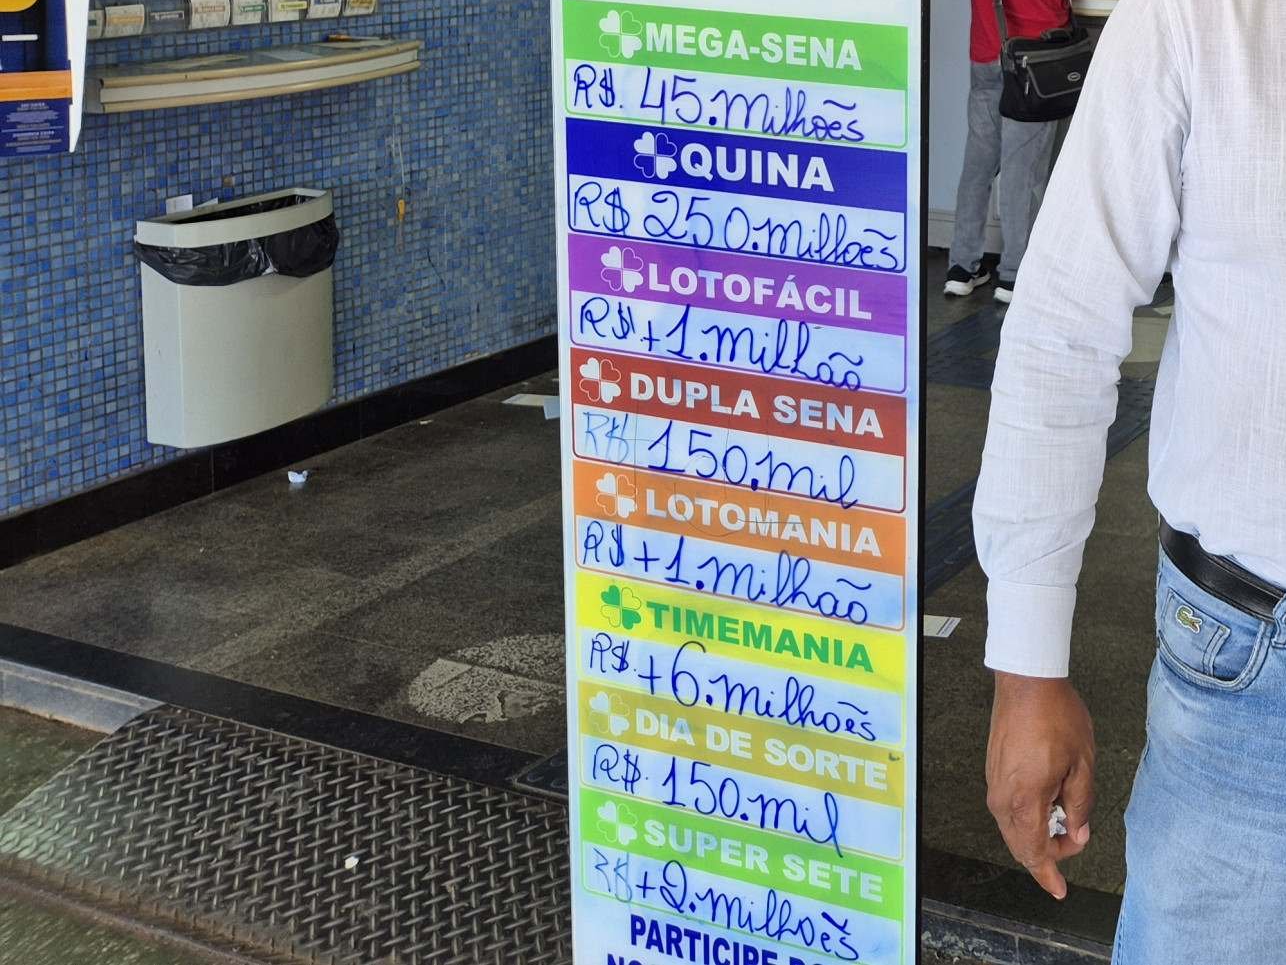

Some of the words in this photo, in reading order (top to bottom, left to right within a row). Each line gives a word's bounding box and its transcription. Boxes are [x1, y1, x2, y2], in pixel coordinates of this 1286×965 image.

[646, 22, 862, 70] MEGA-SENA
[680, 138, 834, 193] QUINA
[648, 263, 872, 321] LOTOFÁCIL
[630, 372, 760, 419] DUPLA
[773, 395, 884, 439] SENA
[646, 489, 882, 558] LOTOMANIA
[646, 600, 874, 674] TIMEMANIA
[635, 709, 695, 746] DIA
[706, 724, 753, 759] DE
[764, 737, 888, 791] SORTE
[644, 819, 770, 875] SUPER
[783, 854, 884, 904] SETE
